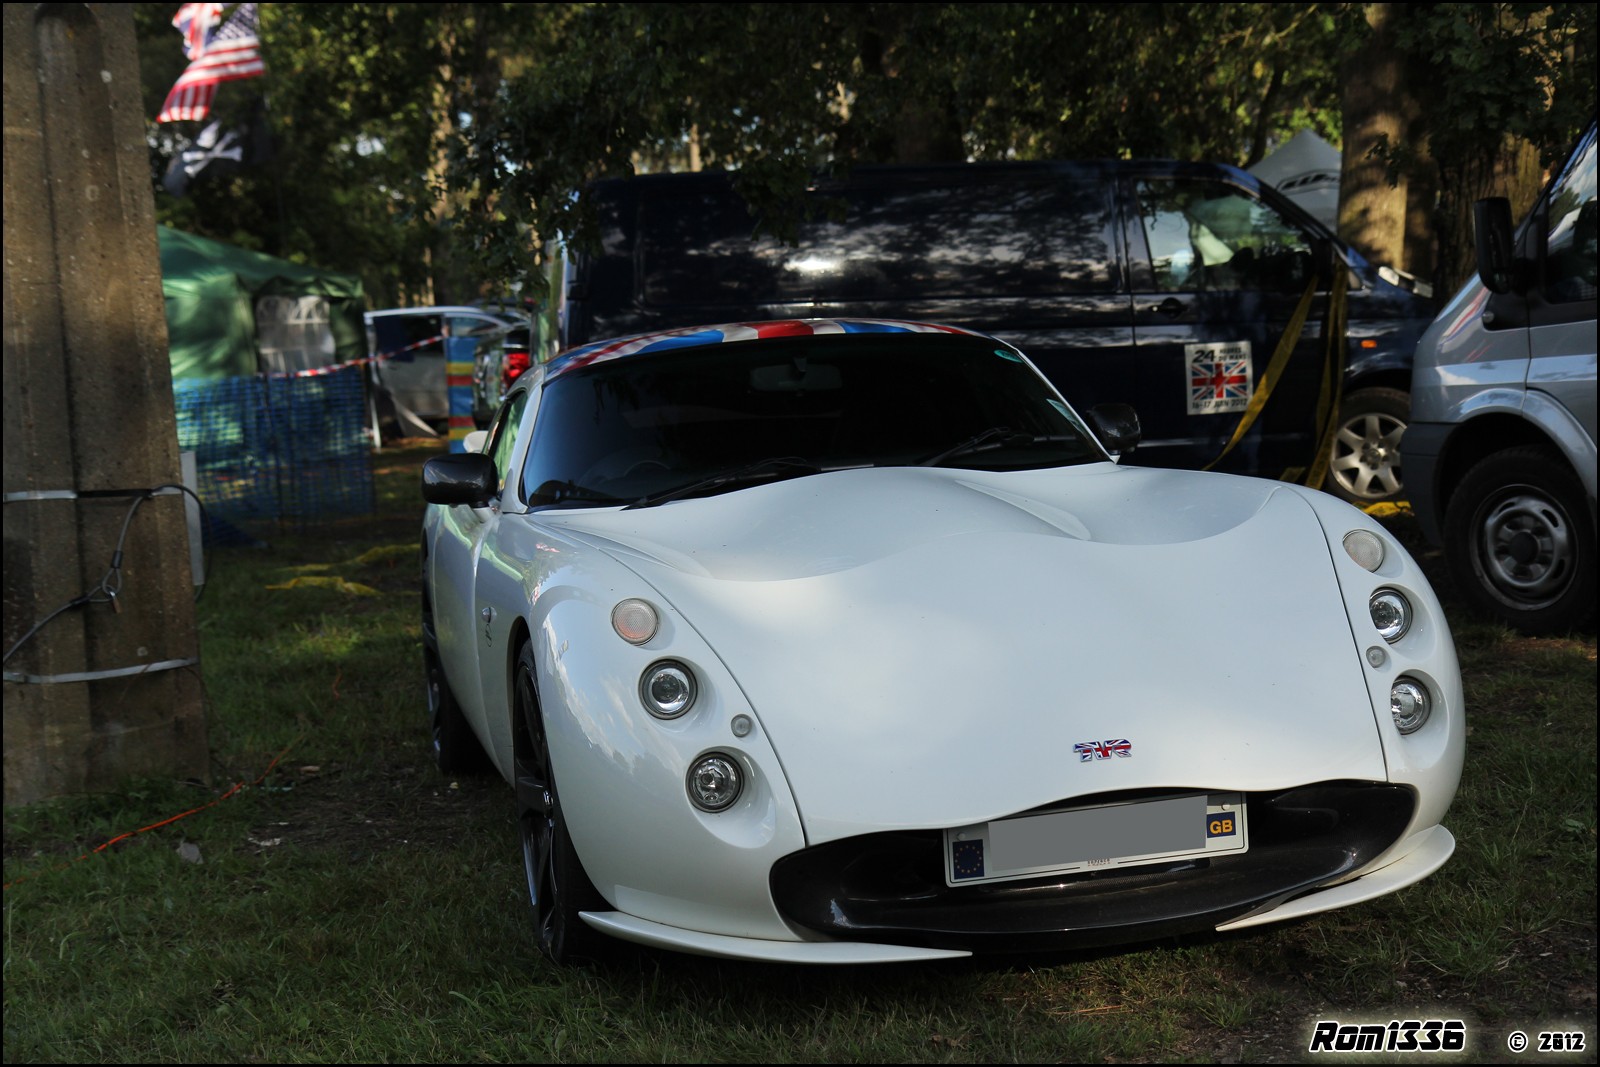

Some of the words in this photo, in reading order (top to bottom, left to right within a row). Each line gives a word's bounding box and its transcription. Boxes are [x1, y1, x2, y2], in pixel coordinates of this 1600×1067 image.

[1192, 349, 1215, 363] 24
[1073, 739, 1132, 763] TVR
[1209, 819, 1233, 835] GB
